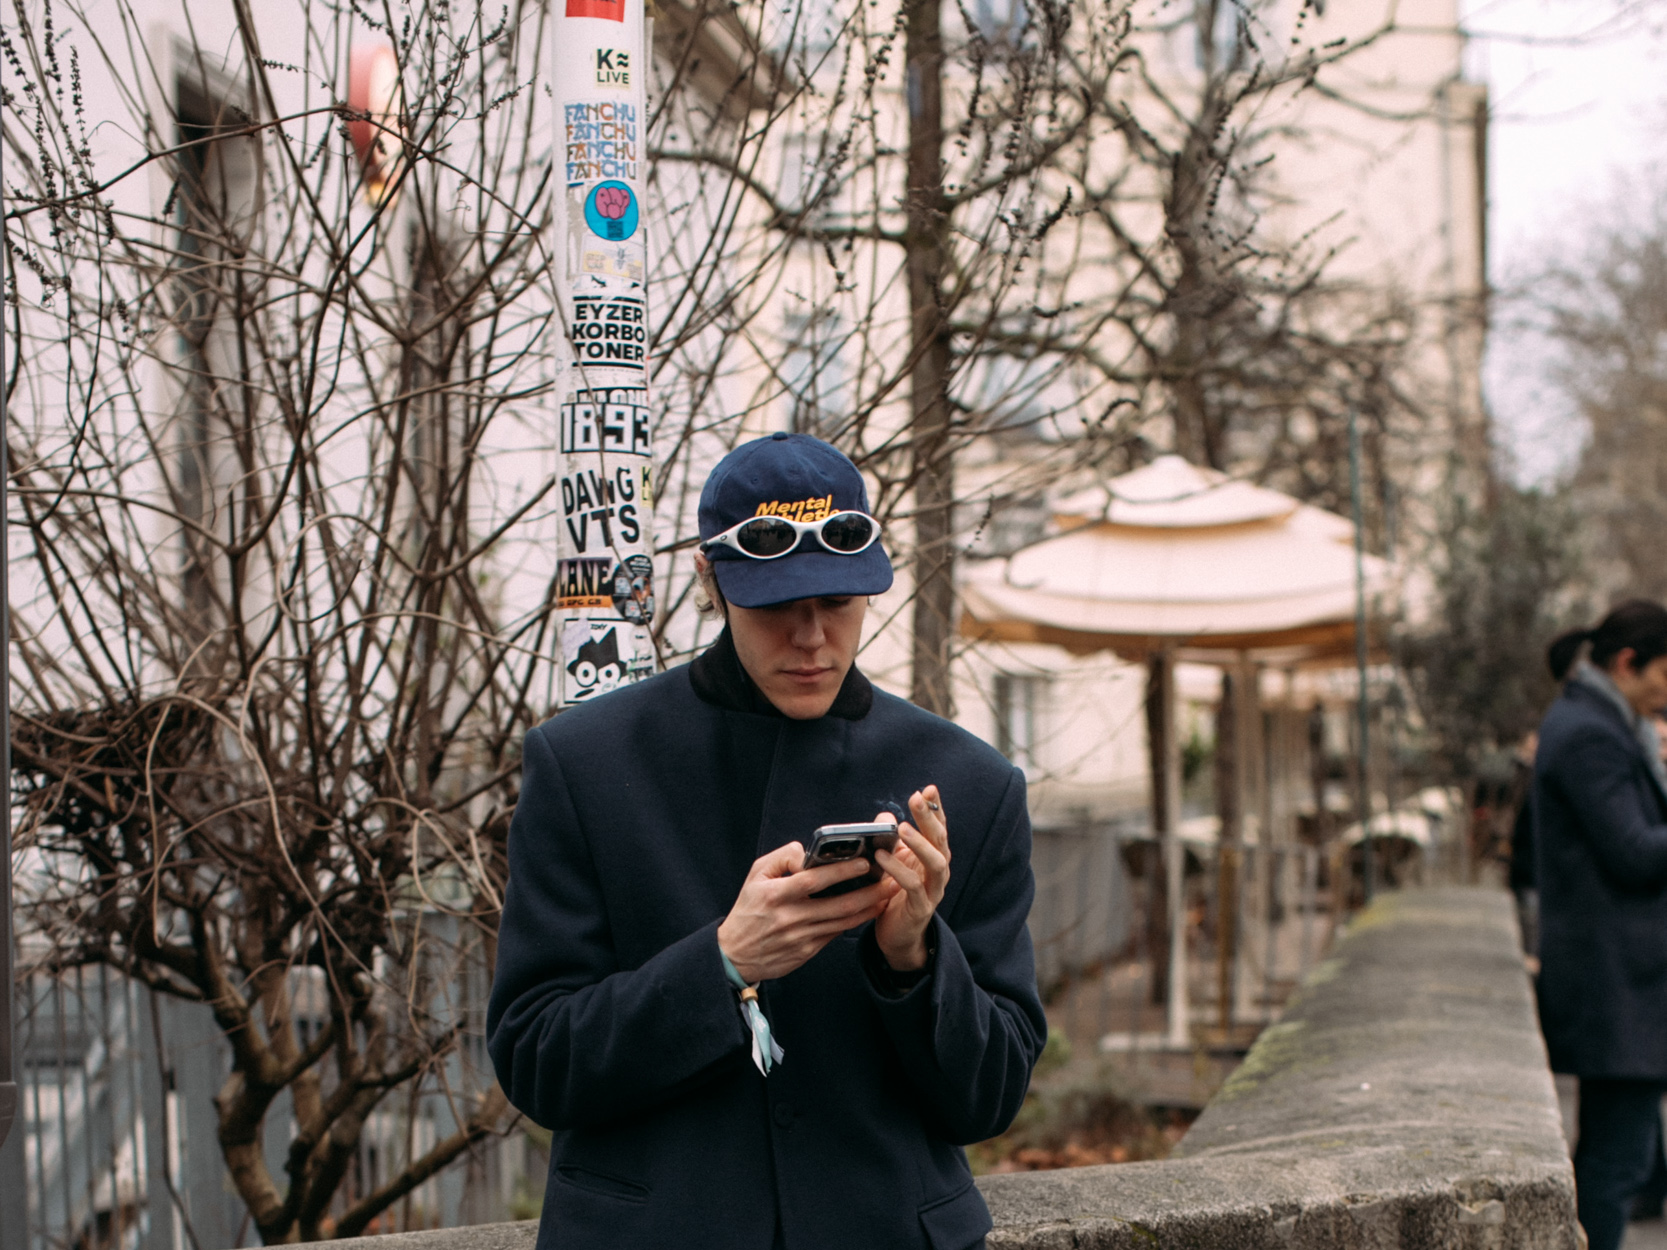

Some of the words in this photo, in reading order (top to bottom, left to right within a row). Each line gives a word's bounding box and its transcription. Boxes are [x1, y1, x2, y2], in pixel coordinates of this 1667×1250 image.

[597, 48, 614, 70] K
[597, 71, 630, 85] LIVE
[564, 102, 636, 123] FANCHU
[565, 121, 636, 142] FANCHU
[566, 141, 636, 161] FANCHU
[566, 159, 636, 181] FANCHU
[575, 303, 643, 324] EYZER
[572, 322, 645, 343] KORBO
[574, 341, 644, 362] TONER
[561, 467, 635, 516] DAWG
[754, 493, 833, 517] Mental
[566, 504, 640, 554] VTS
